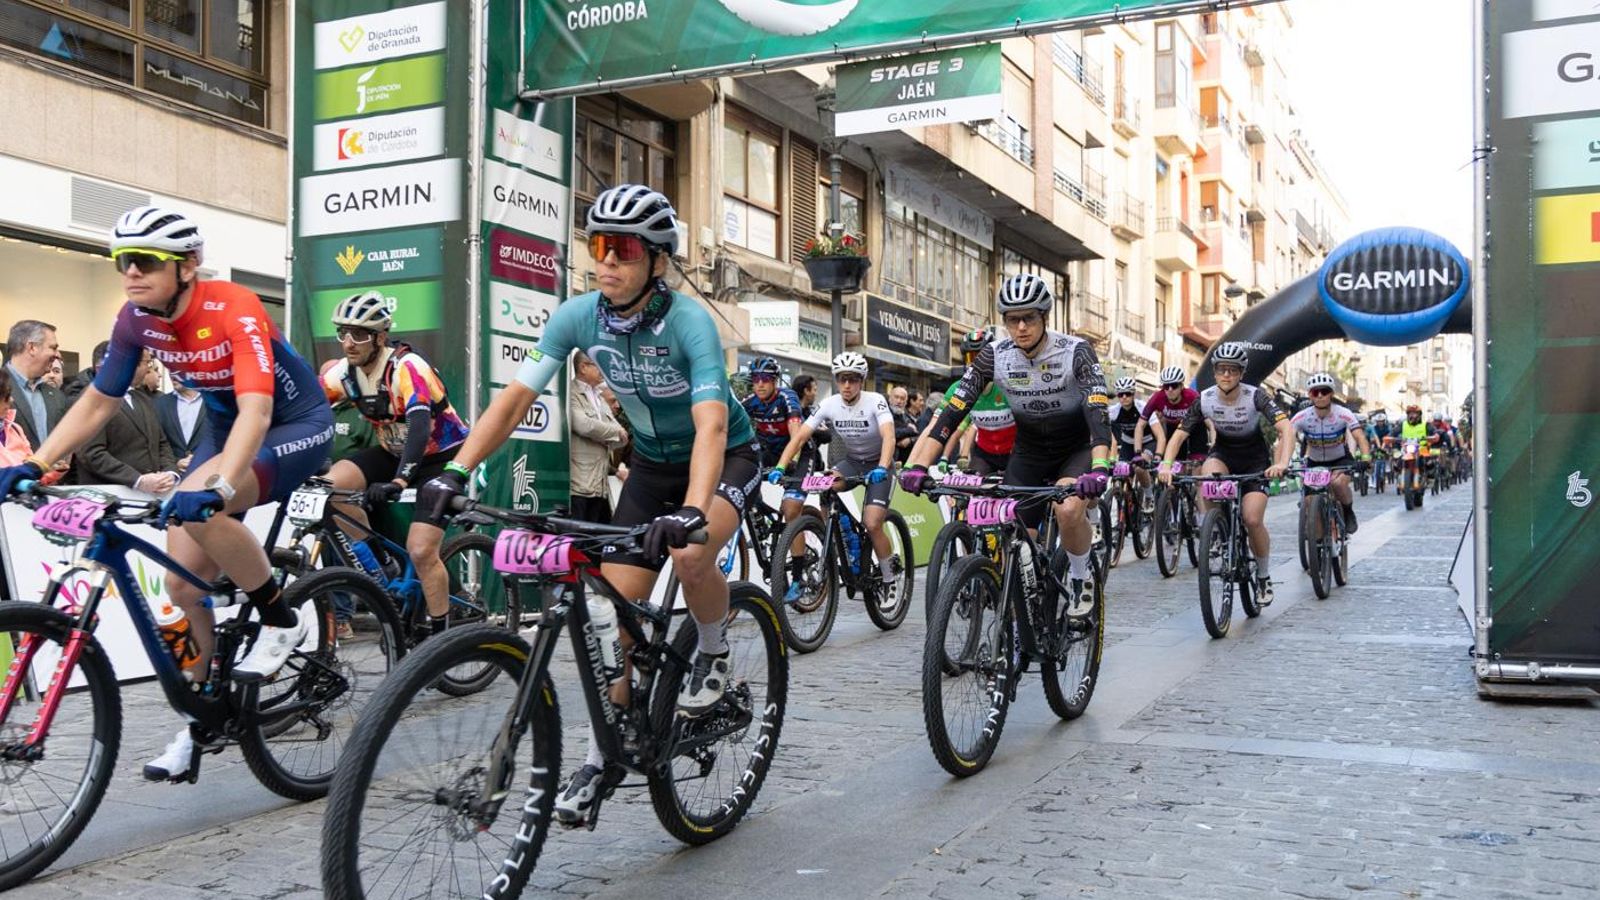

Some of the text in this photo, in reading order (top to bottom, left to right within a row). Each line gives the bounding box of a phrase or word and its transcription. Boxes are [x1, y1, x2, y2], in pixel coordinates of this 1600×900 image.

[567, 0, 648, 31] CÓRDOBA
[367, 36, 421, 52] de Granada
[368, 25, 418, 41] Diputación
[870, 57, 964, 83] STAGE 3
[146, 63, 260, 111] MURIANA
[897, 79, 936, 100] JAÉN
[887, 107, 947, 124] GARMIN
[368, 127, 417, 142] Diputación
[324, 182, 432, 214] GARMIN
[493, 184, 559, 220] GARMIN
[367, 247, 420, 262] CAJA RURAL
[382, 260, 405, 272] JAÉN
[512, 246, 556, 270] IMDECO
[1333, 268, 1450, 291] GARMIN
[879, 310, 917, 337] VERÓNICA
[922, 324, 940, 343] JESÚS
[143, 340, 233, 363] TORPADO
[273, 362, 300, 400] NITOU
[609, 369, 687, 387] BIKE RACE
[1006, 386, 1067, 397] cannondale
[272, 424, 335, 458] TORPADO
[1566, 470, 1592, 508] 15
[291, 494, 318, 515] 56-1
